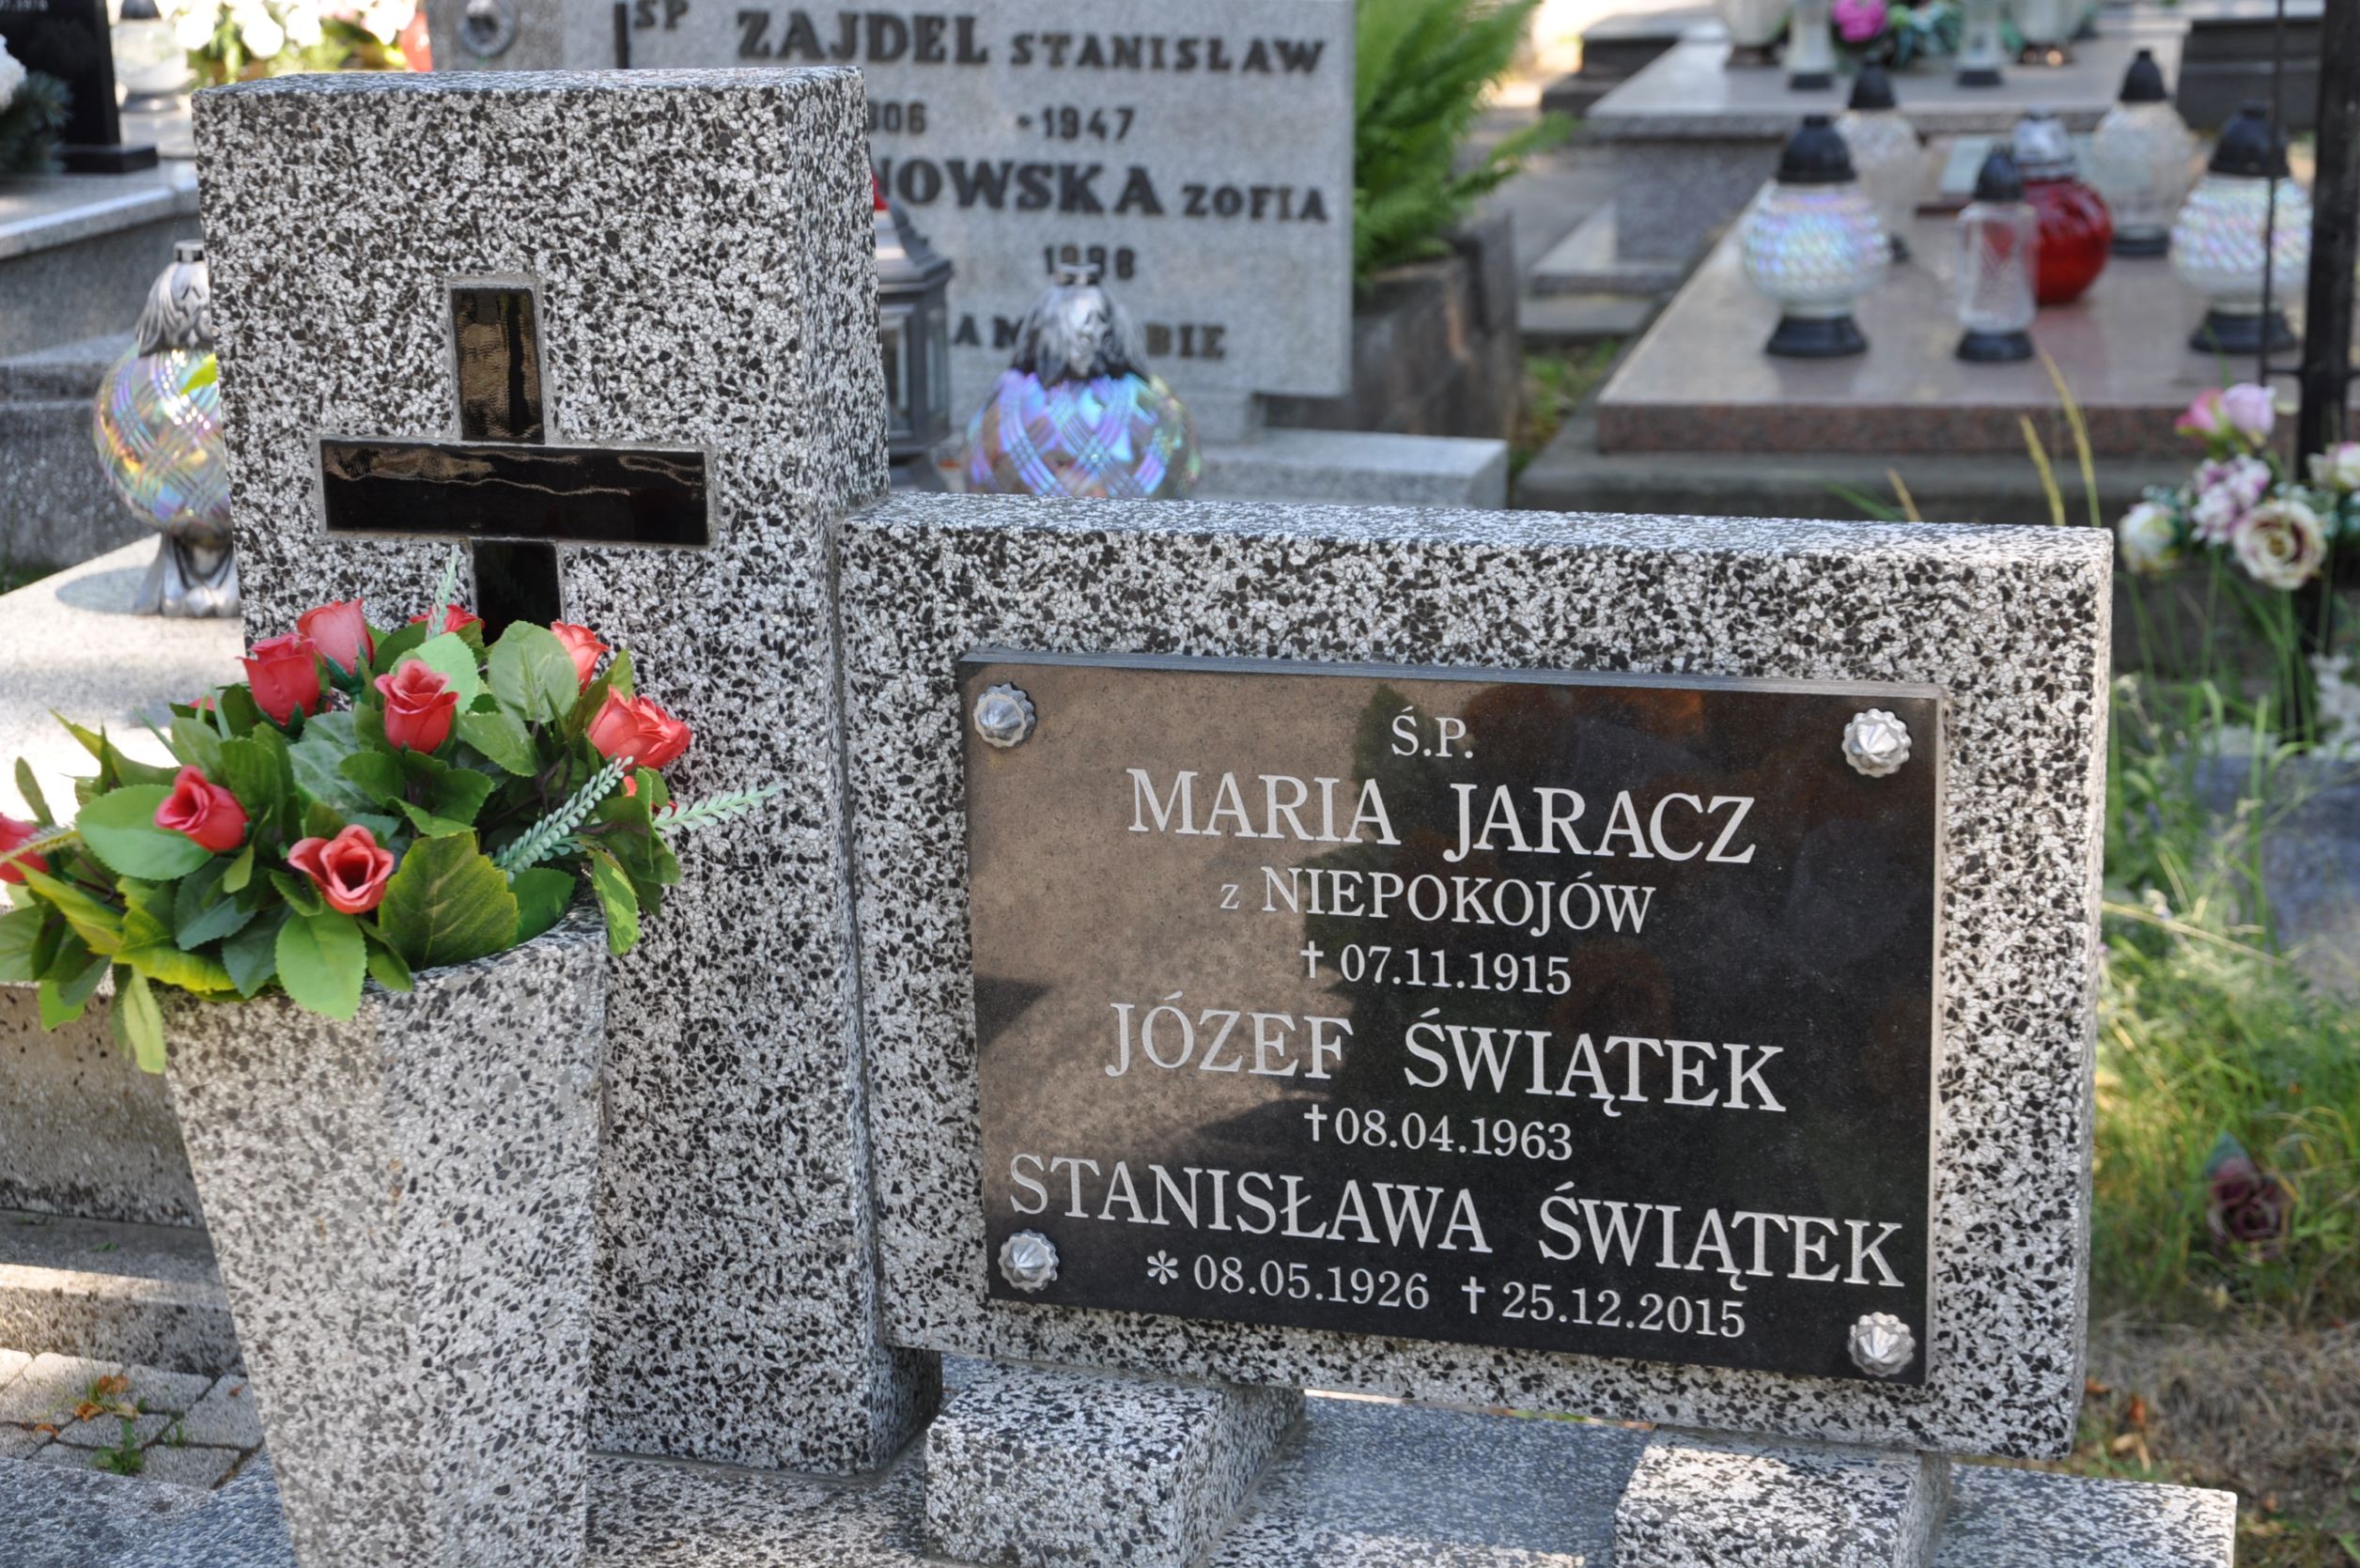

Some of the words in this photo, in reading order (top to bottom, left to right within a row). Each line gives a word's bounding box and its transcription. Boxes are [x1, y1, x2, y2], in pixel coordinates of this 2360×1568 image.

[737, 9, 988, 64] ZAJDEL
[1042, 105, 1136, 142] 1947
[1181, 185, 1328, 222] ZOFIA
[1391, 705, 1474, 759] Ś.P.
[1126, 768, 1402, 846] MARIA
[1442, 783, 1757, 865] JARACZ
[1219, 884, 1240, 911] z
[1260, 866, 1657, 938] NIEPOKOJÓW
[1340, 943, 1572, 996] 07.11.1915
[1105, 990, 1354, 1079] JÓZEF
[1404, 1006, 1787, 1118] ŚWIĄTEK
[1335, 1107, 1573, 1161] 08.04.1963
[1010, 1154, 1494, 1253] STANISŁAWA
[1538, 1180, 1905, 1292] ŚWIĄTEK
[1193, 1254, 1430, 1310] 08.05.1926
[1501, 1281, 1747, 1338] 25.12.2015
